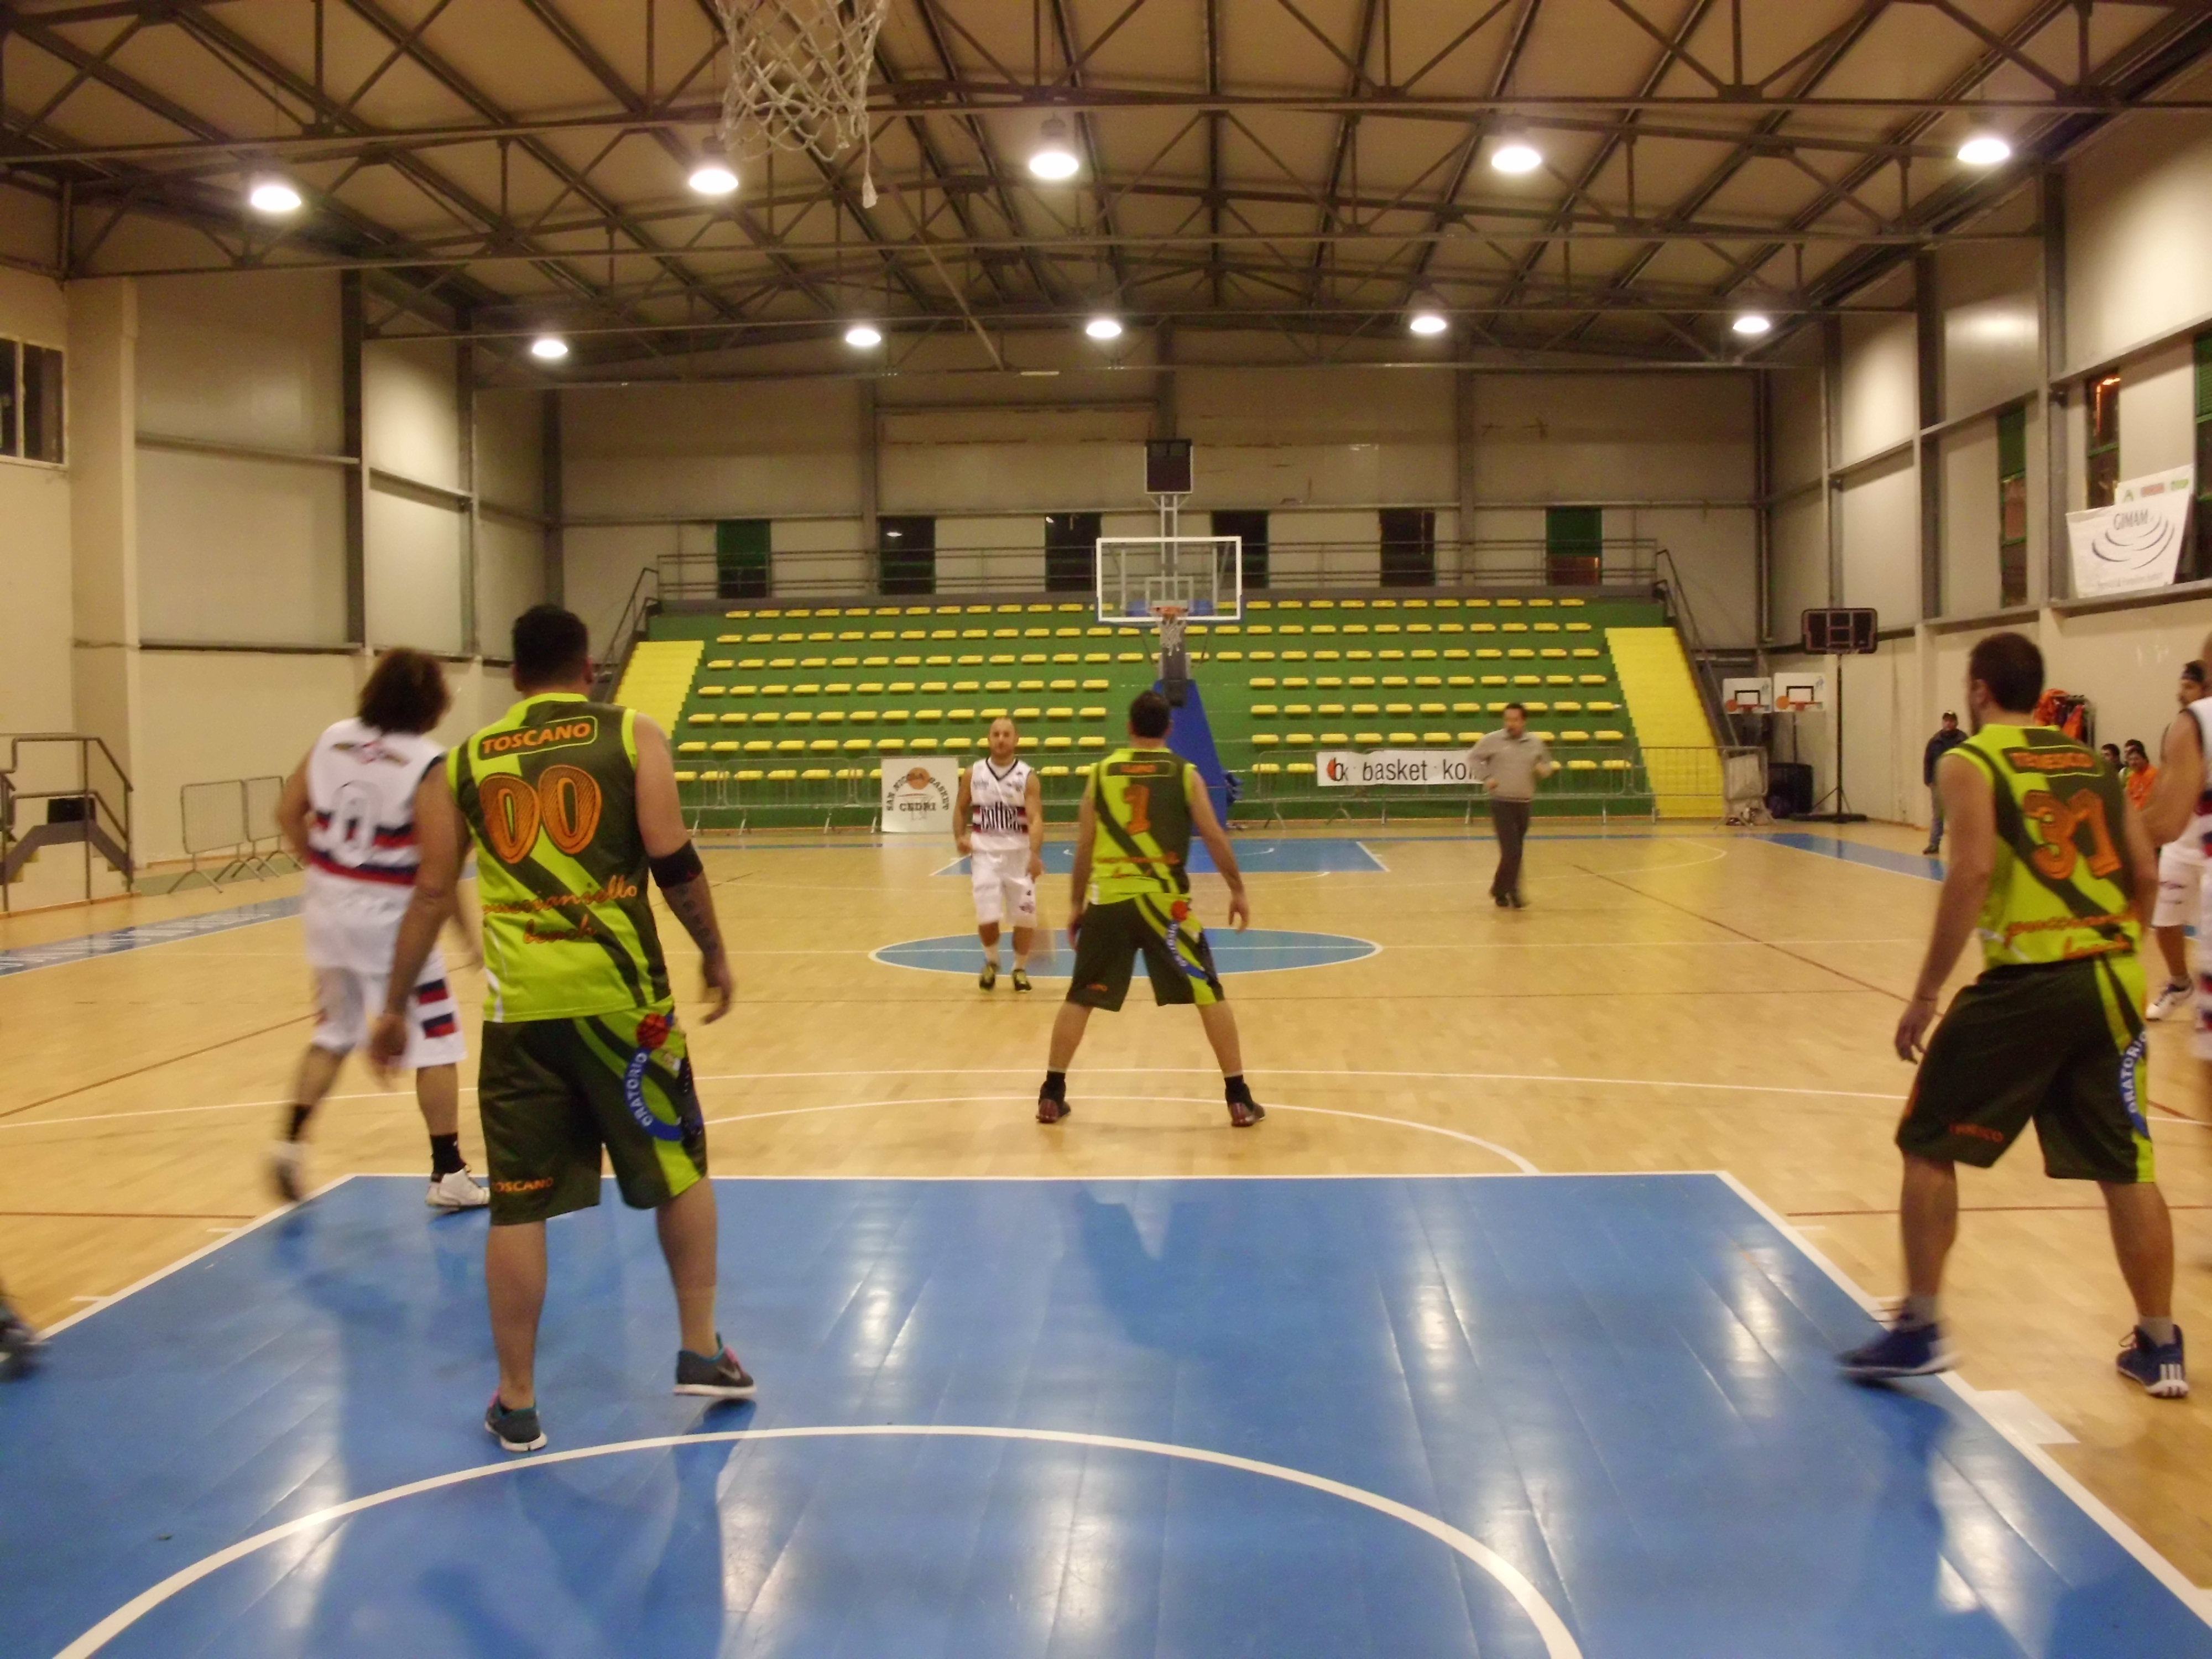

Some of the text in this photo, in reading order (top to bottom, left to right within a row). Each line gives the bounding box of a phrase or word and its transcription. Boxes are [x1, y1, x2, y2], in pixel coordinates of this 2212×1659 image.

[482, 723, 591, 753] TOSCANO
[1363, 758, 1427, 781] basket
[479, 765, 602, 864] 00
[886, 792, 895, 811] SAN
[899, 802, 936, 811] CEDRI
[1123, 784, 1151, 835] 1
[2022, 788, 2122, 880] 31
[625, 1052, 654, 1126] ORATORIO
[2120, 1031, 2147, 1113] ORATORIO
